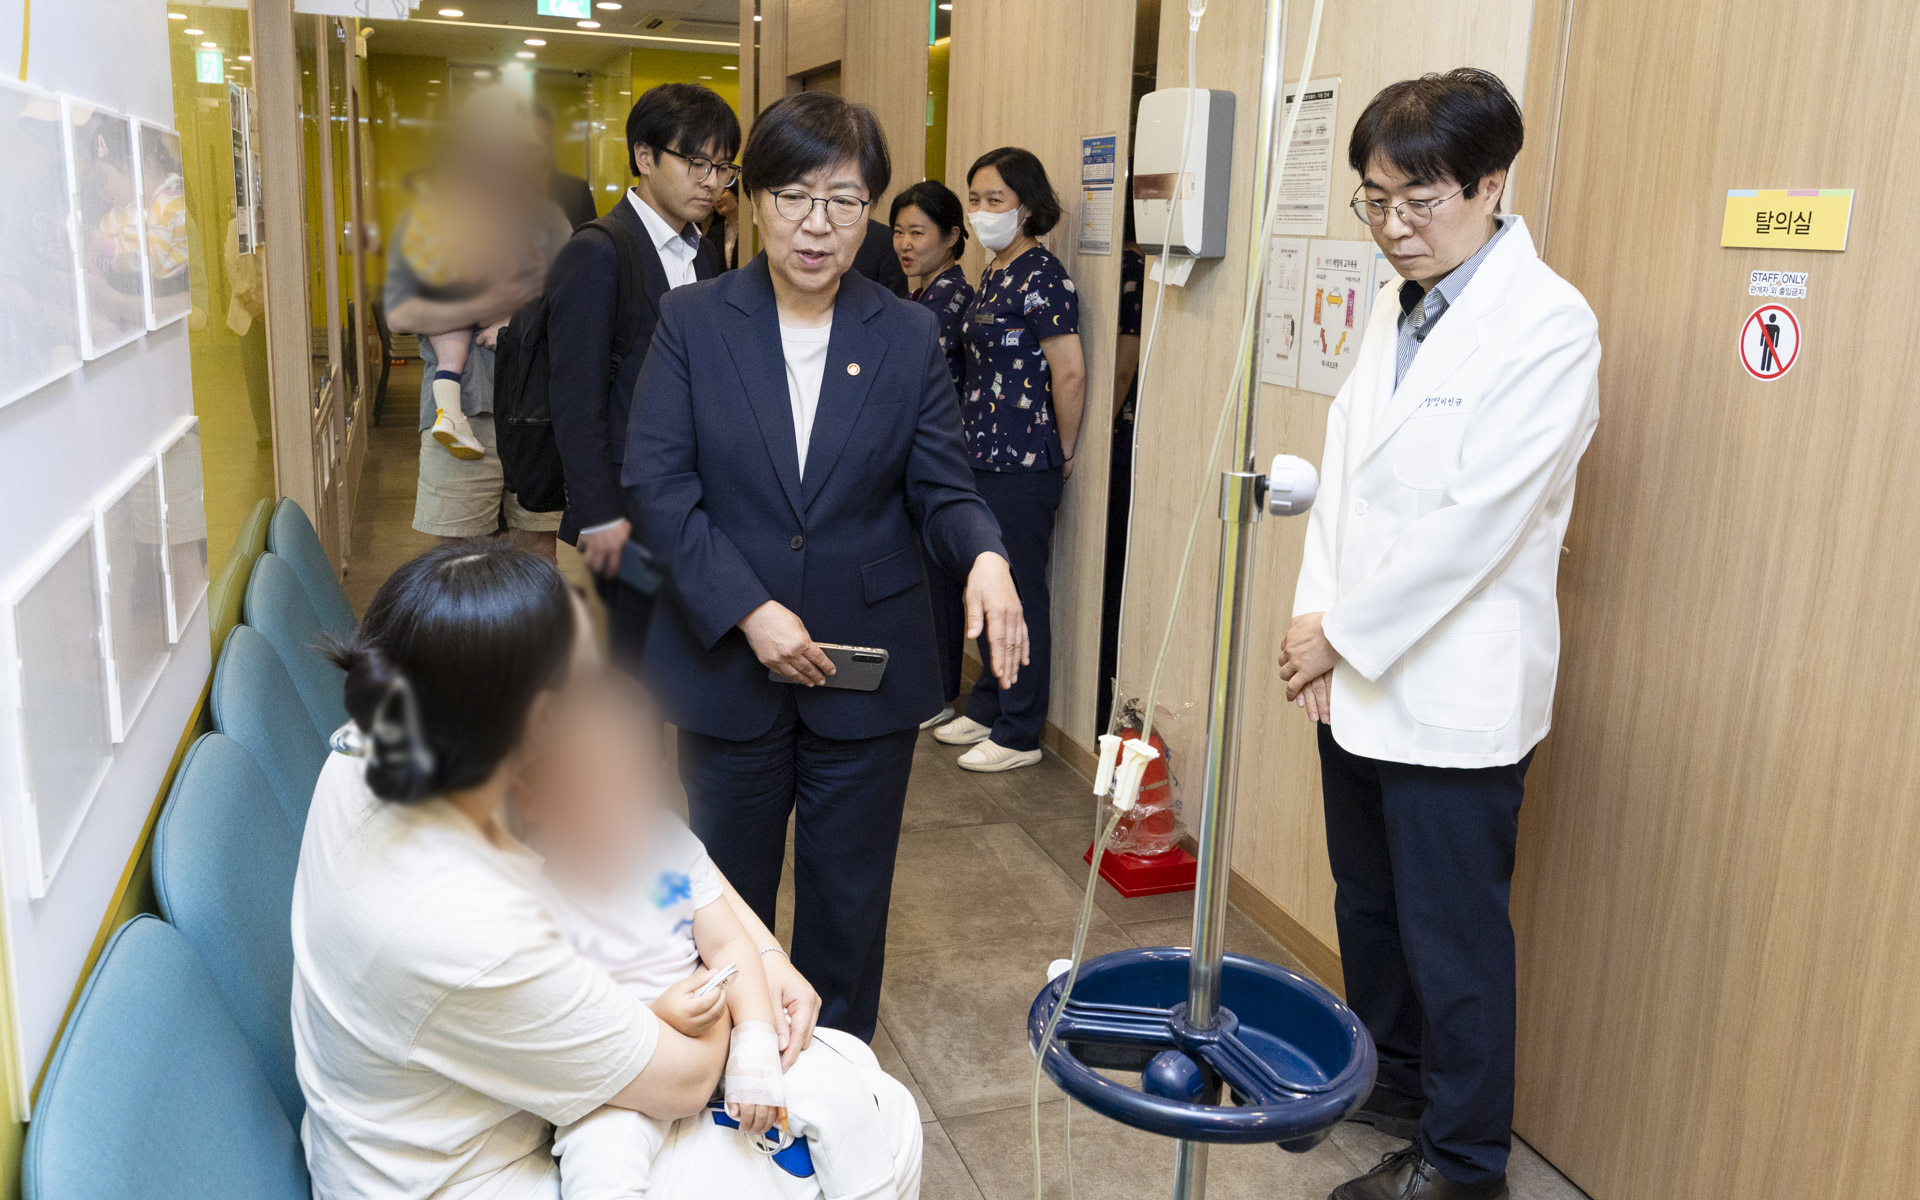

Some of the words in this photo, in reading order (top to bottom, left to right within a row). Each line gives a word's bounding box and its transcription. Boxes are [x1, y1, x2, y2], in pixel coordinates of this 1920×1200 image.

[1755, 210, 1813, 235] 탈의실
[1751, 272, 1779, 282] STAFF
[1782, 273, 1807, 284] ONLY
[1750, 285, 1769, 294] 관계자
[1770, 286, 1778, 295] 외
[1779, 287, 1805, 297] 출입금지
